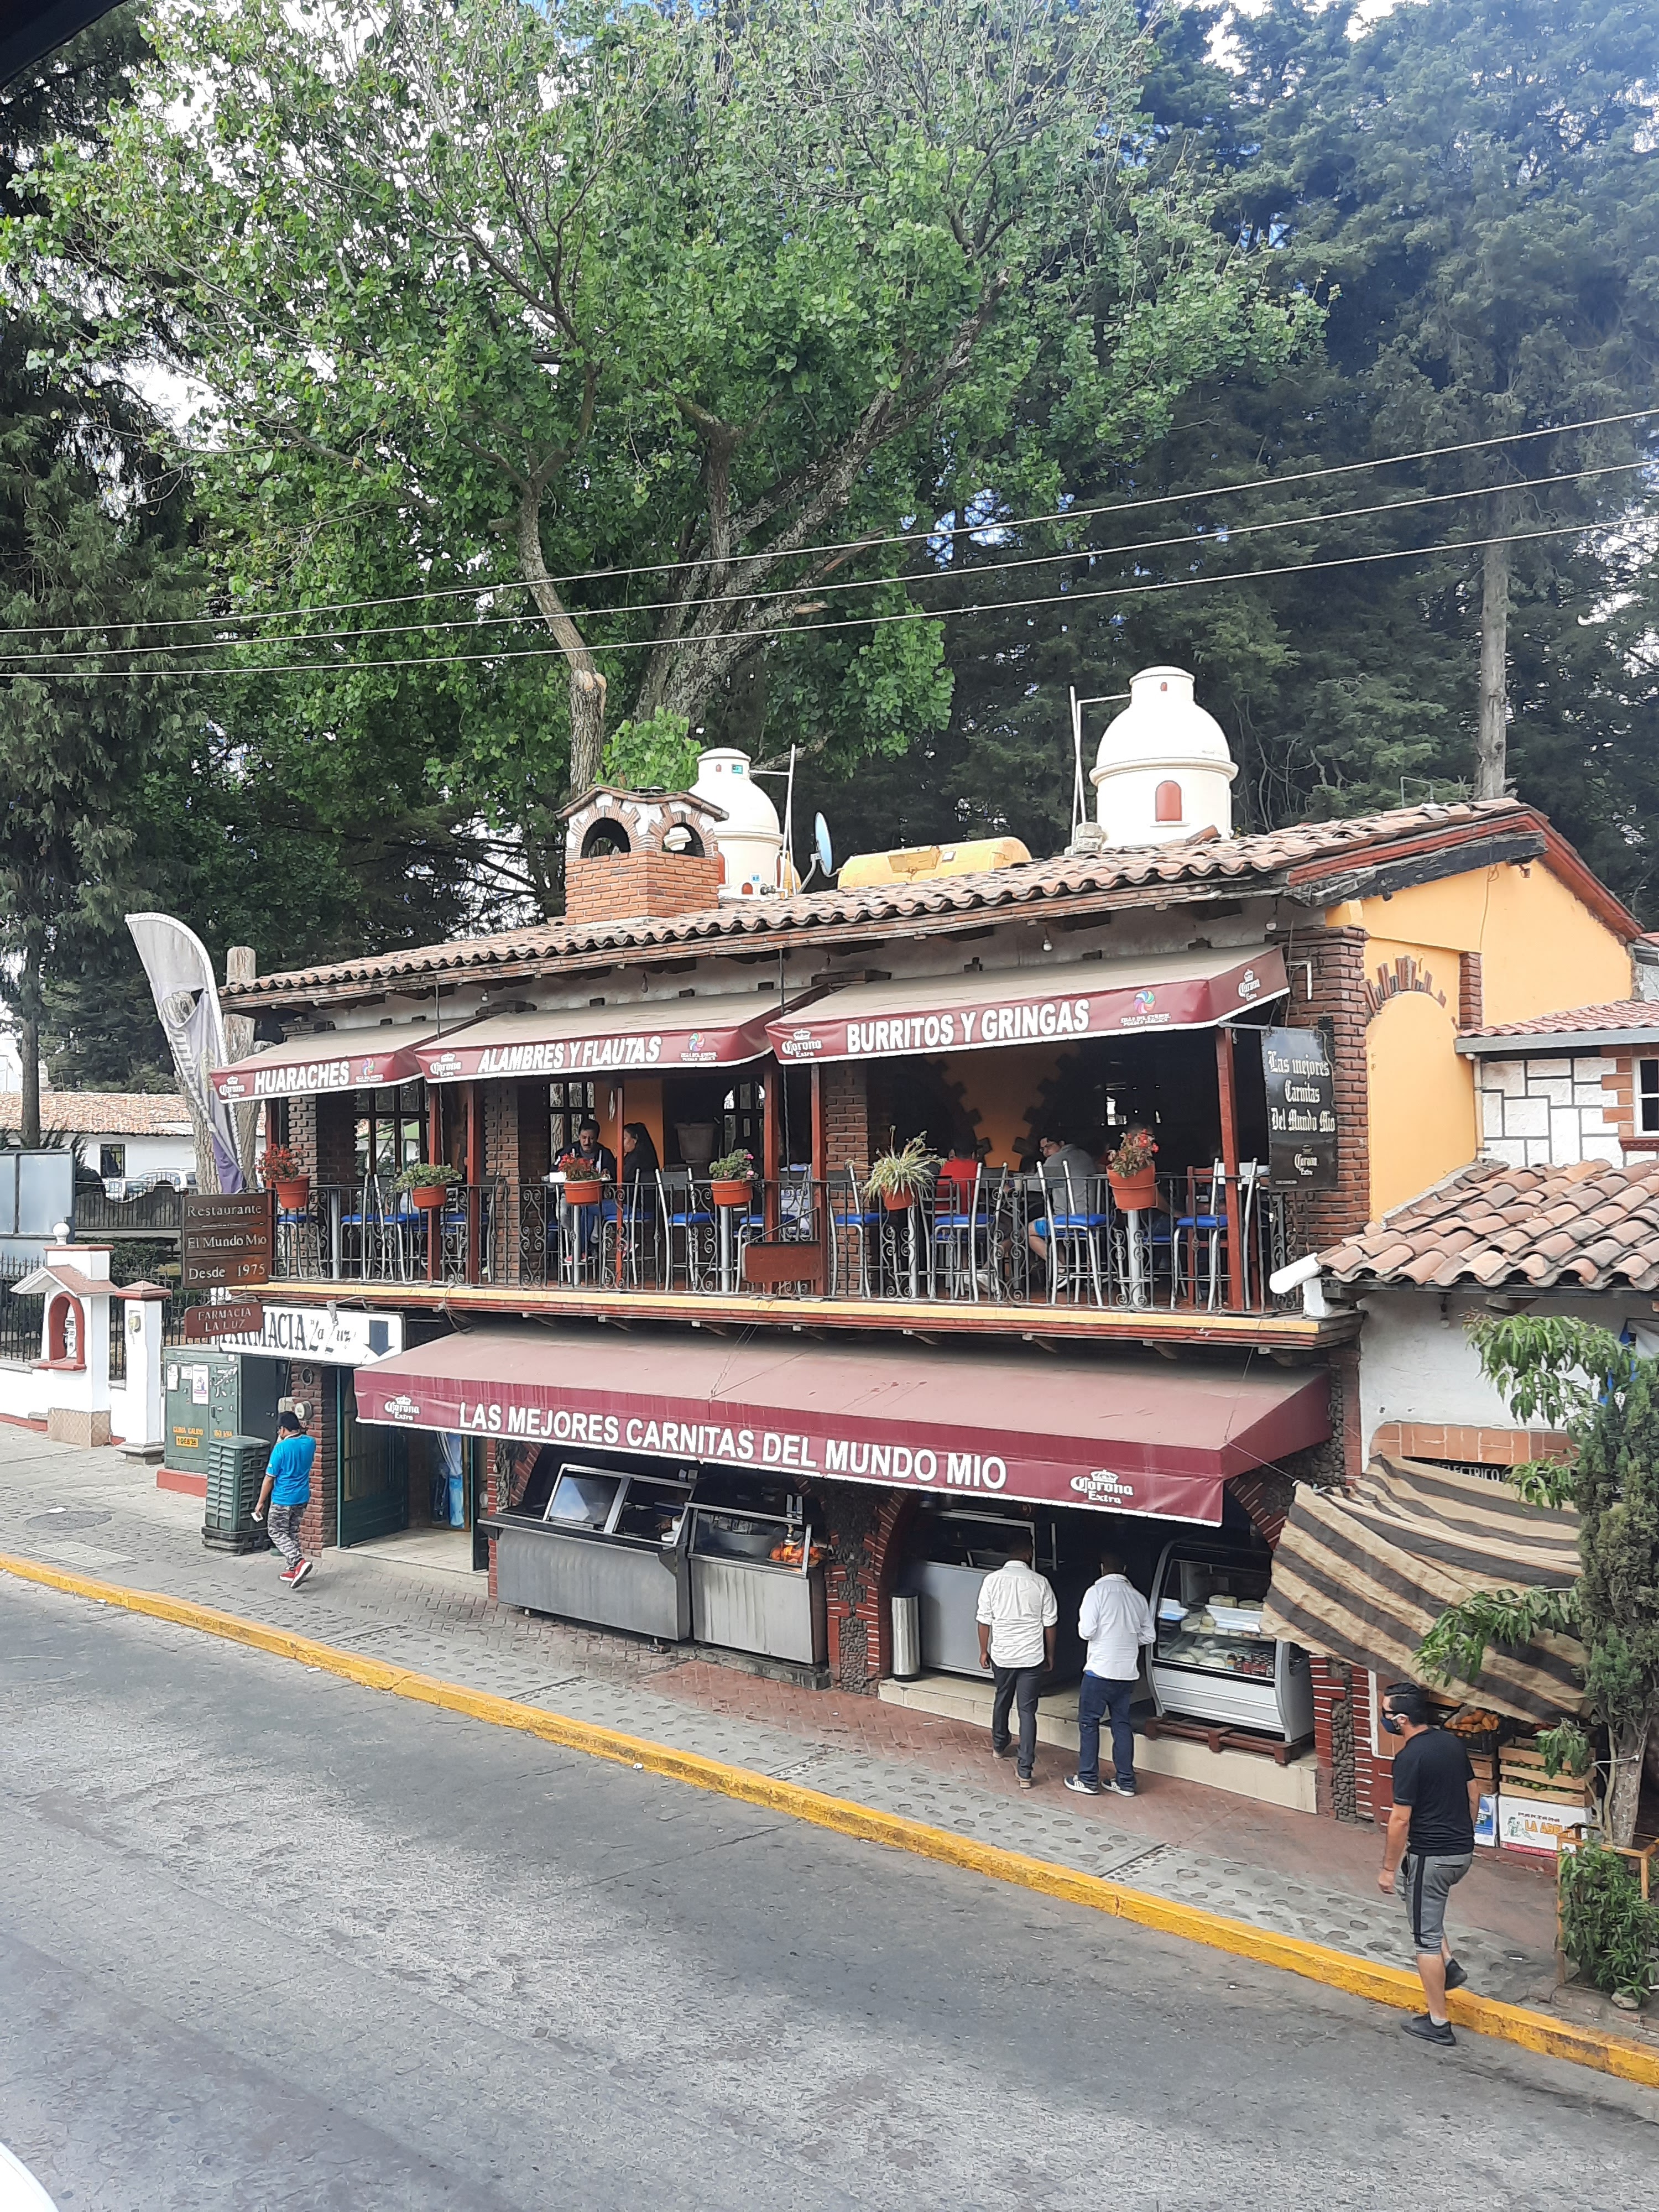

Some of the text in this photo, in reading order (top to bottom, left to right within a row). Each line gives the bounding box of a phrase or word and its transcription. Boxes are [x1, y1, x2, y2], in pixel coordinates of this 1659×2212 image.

[847, 999, 1090, 1053] BURRITOS Y GRINGAS
[477, 1035, 662, 1073] ALAMBRES Y FLAUTAS
[781, 1040, 822, 1056] Corona
[430, 1062, 462, 1075] Corona
[1267, 1050, 1330, 1079] Las mejores
[254, 1061, 349, 1095] HUARACHES
[1285, 1079, 1321, 1103] Carnitas
[1271, 1107, 1286, 1131] Del
[1288, 1108, 1318, 1132] Mundo
[187, 1205, 262, 1217] Restaurante
[188, 1237, 199, 1249] El
[203, 1234, 243, 1248] Mundo
[189, 1263, 265, 1280] Desde 1975
[198, 1307, 251, 1321] FARMACIA
[205, 1319, 246, 1333] LA LUZ
[384, 1401, 420, 1414] Corona
[459, 1402, 1007, 1489] LAS MEJORES CARNITAS DEL MUNDO MIO
[1070, 1476, 1134, 1496] Corona
[1088, 1490, 1122, 1504] Extra
[1525, 1819, 1538, 1833] LA
